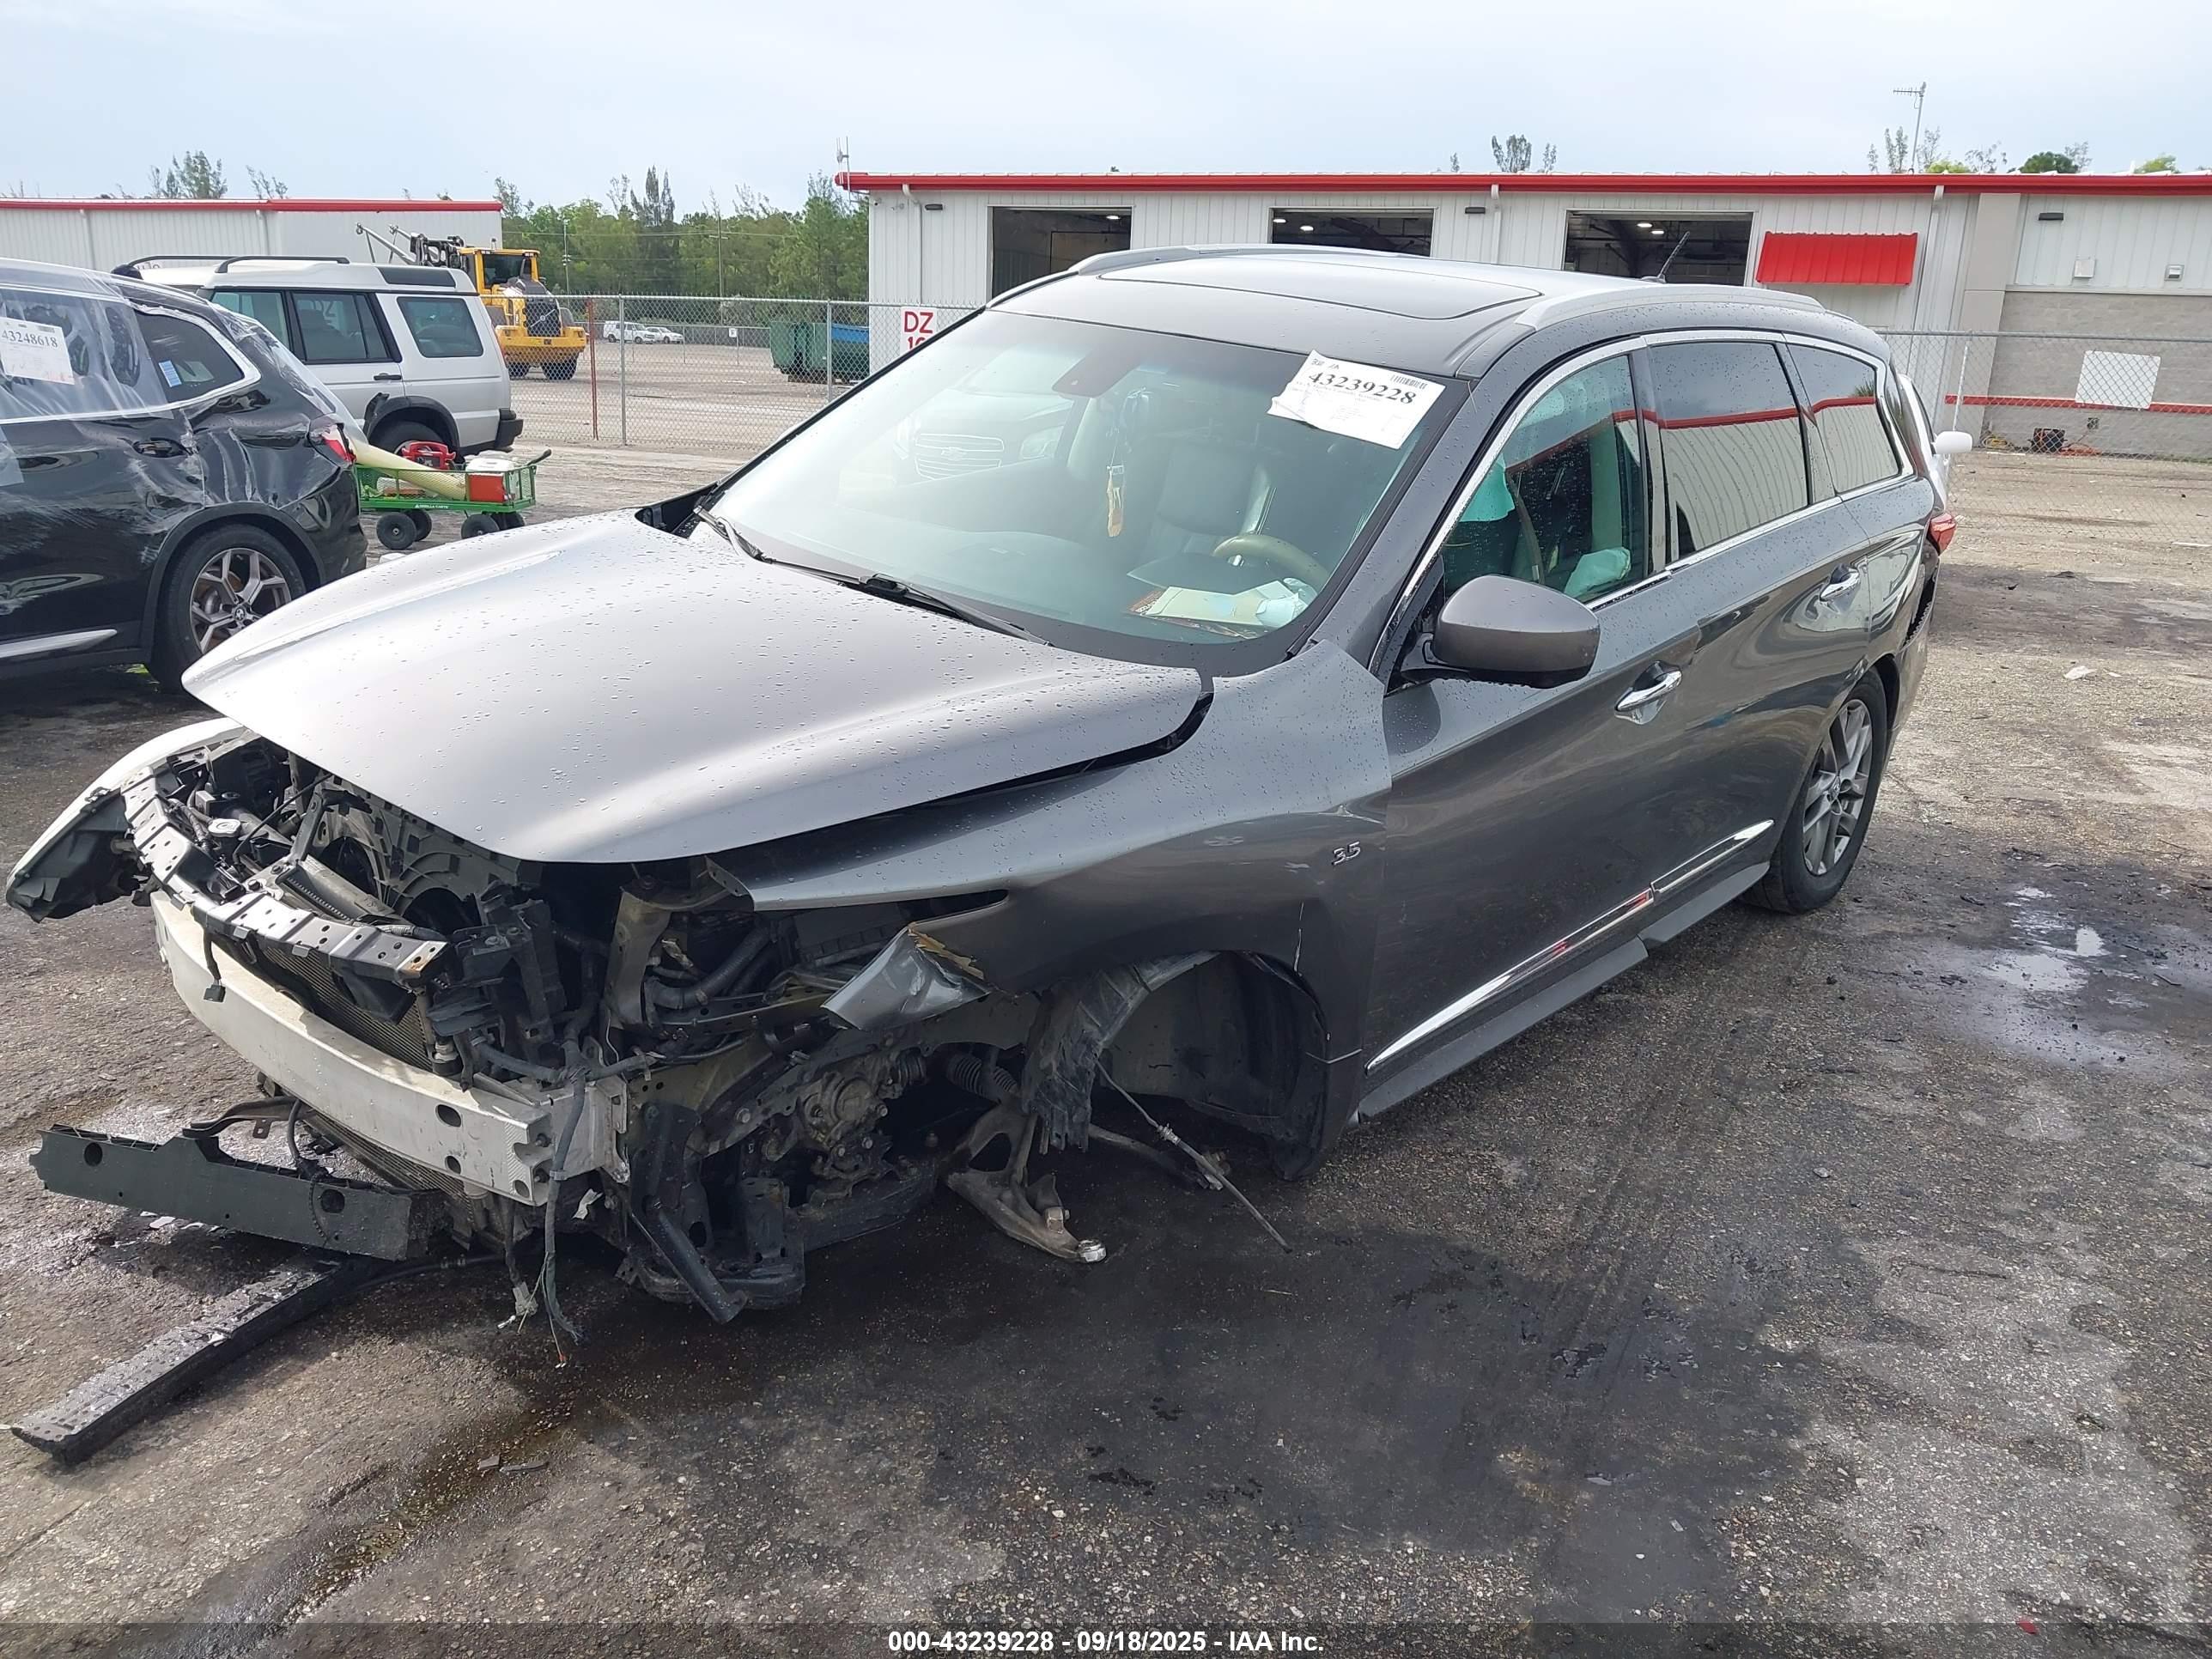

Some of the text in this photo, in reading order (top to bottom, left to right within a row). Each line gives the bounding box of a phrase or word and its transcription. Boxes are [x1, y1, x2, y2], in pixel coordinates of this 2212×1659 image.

[904, 311, 933, 334] DZ
[2, 330, 58, 349] 43248618
[1309, 371, 1417, 404] 43239228
